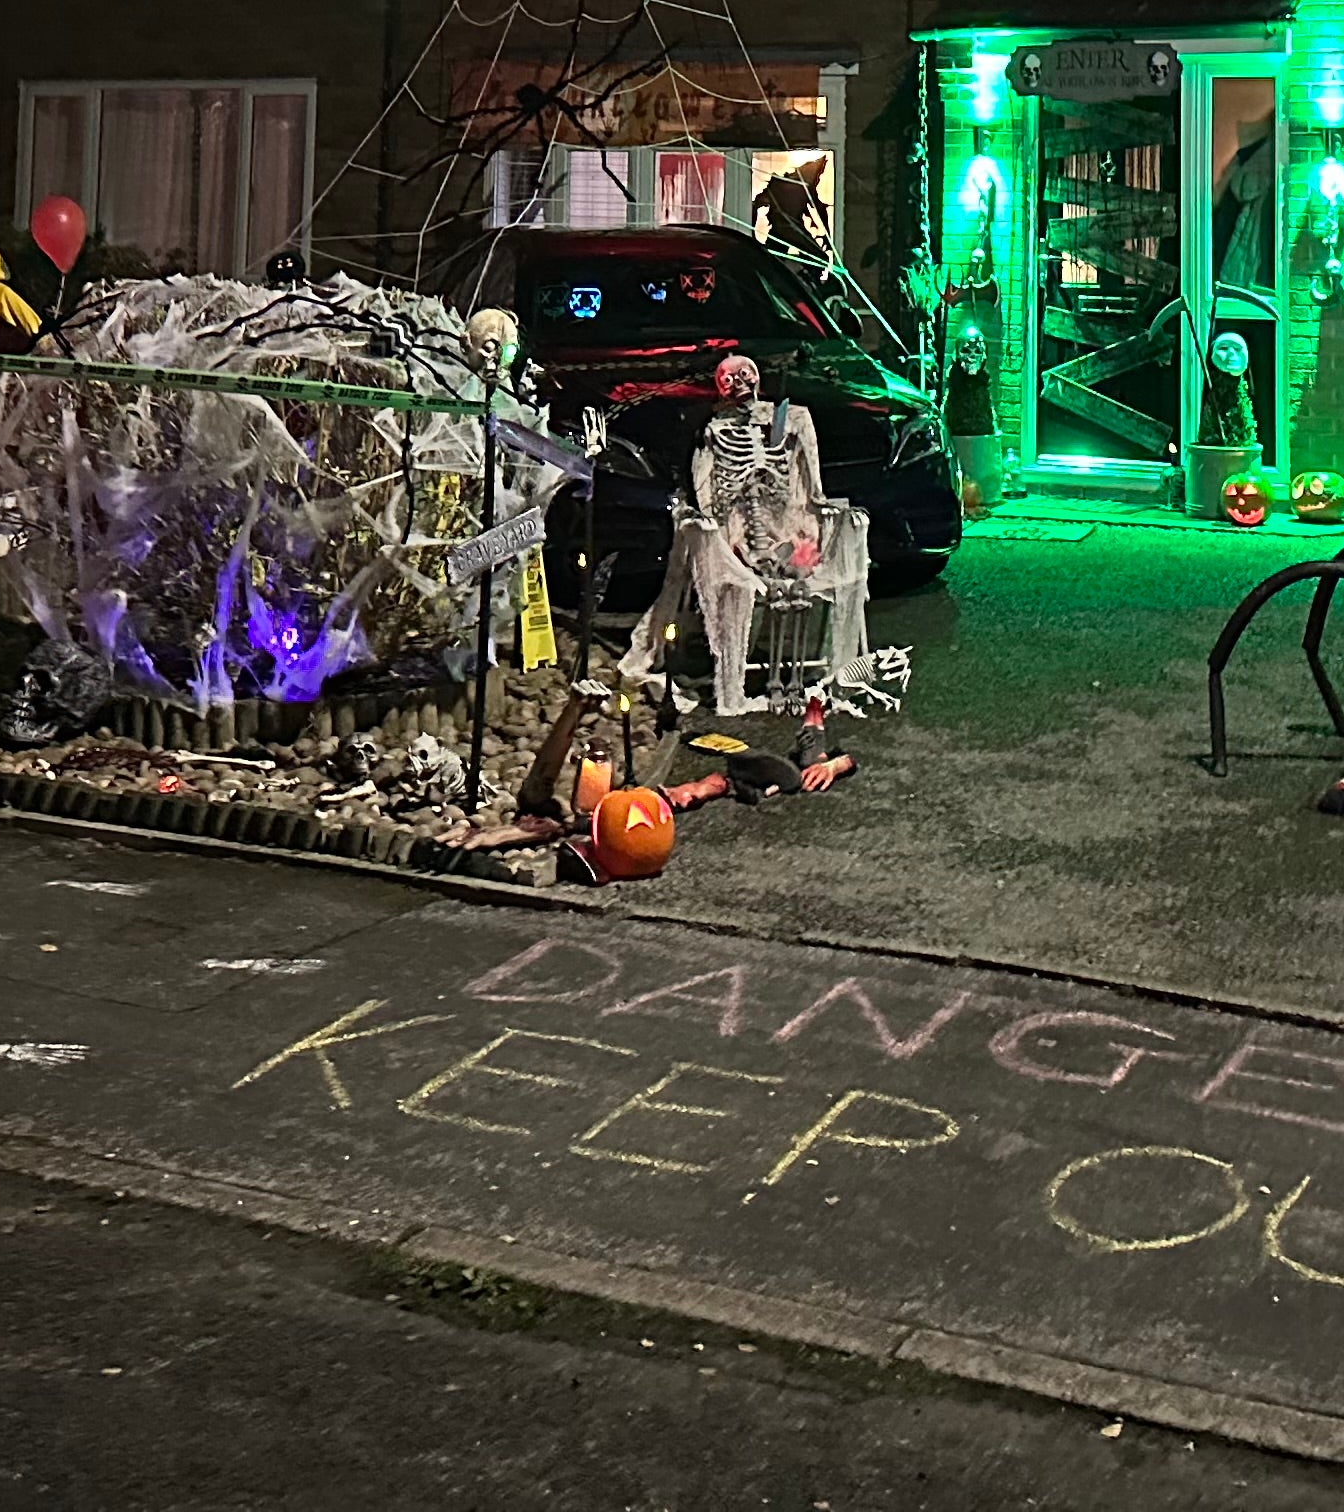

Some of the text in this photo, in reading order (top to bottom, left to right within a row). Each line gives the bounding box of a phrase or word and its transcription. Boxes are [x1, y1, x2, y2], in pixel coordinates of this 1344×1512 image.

[1055, 48, 1131, 73] ENTER
[451, 517, 538, 572] GRAVEYARD
[229, 998, 964, 1194] KEEP
